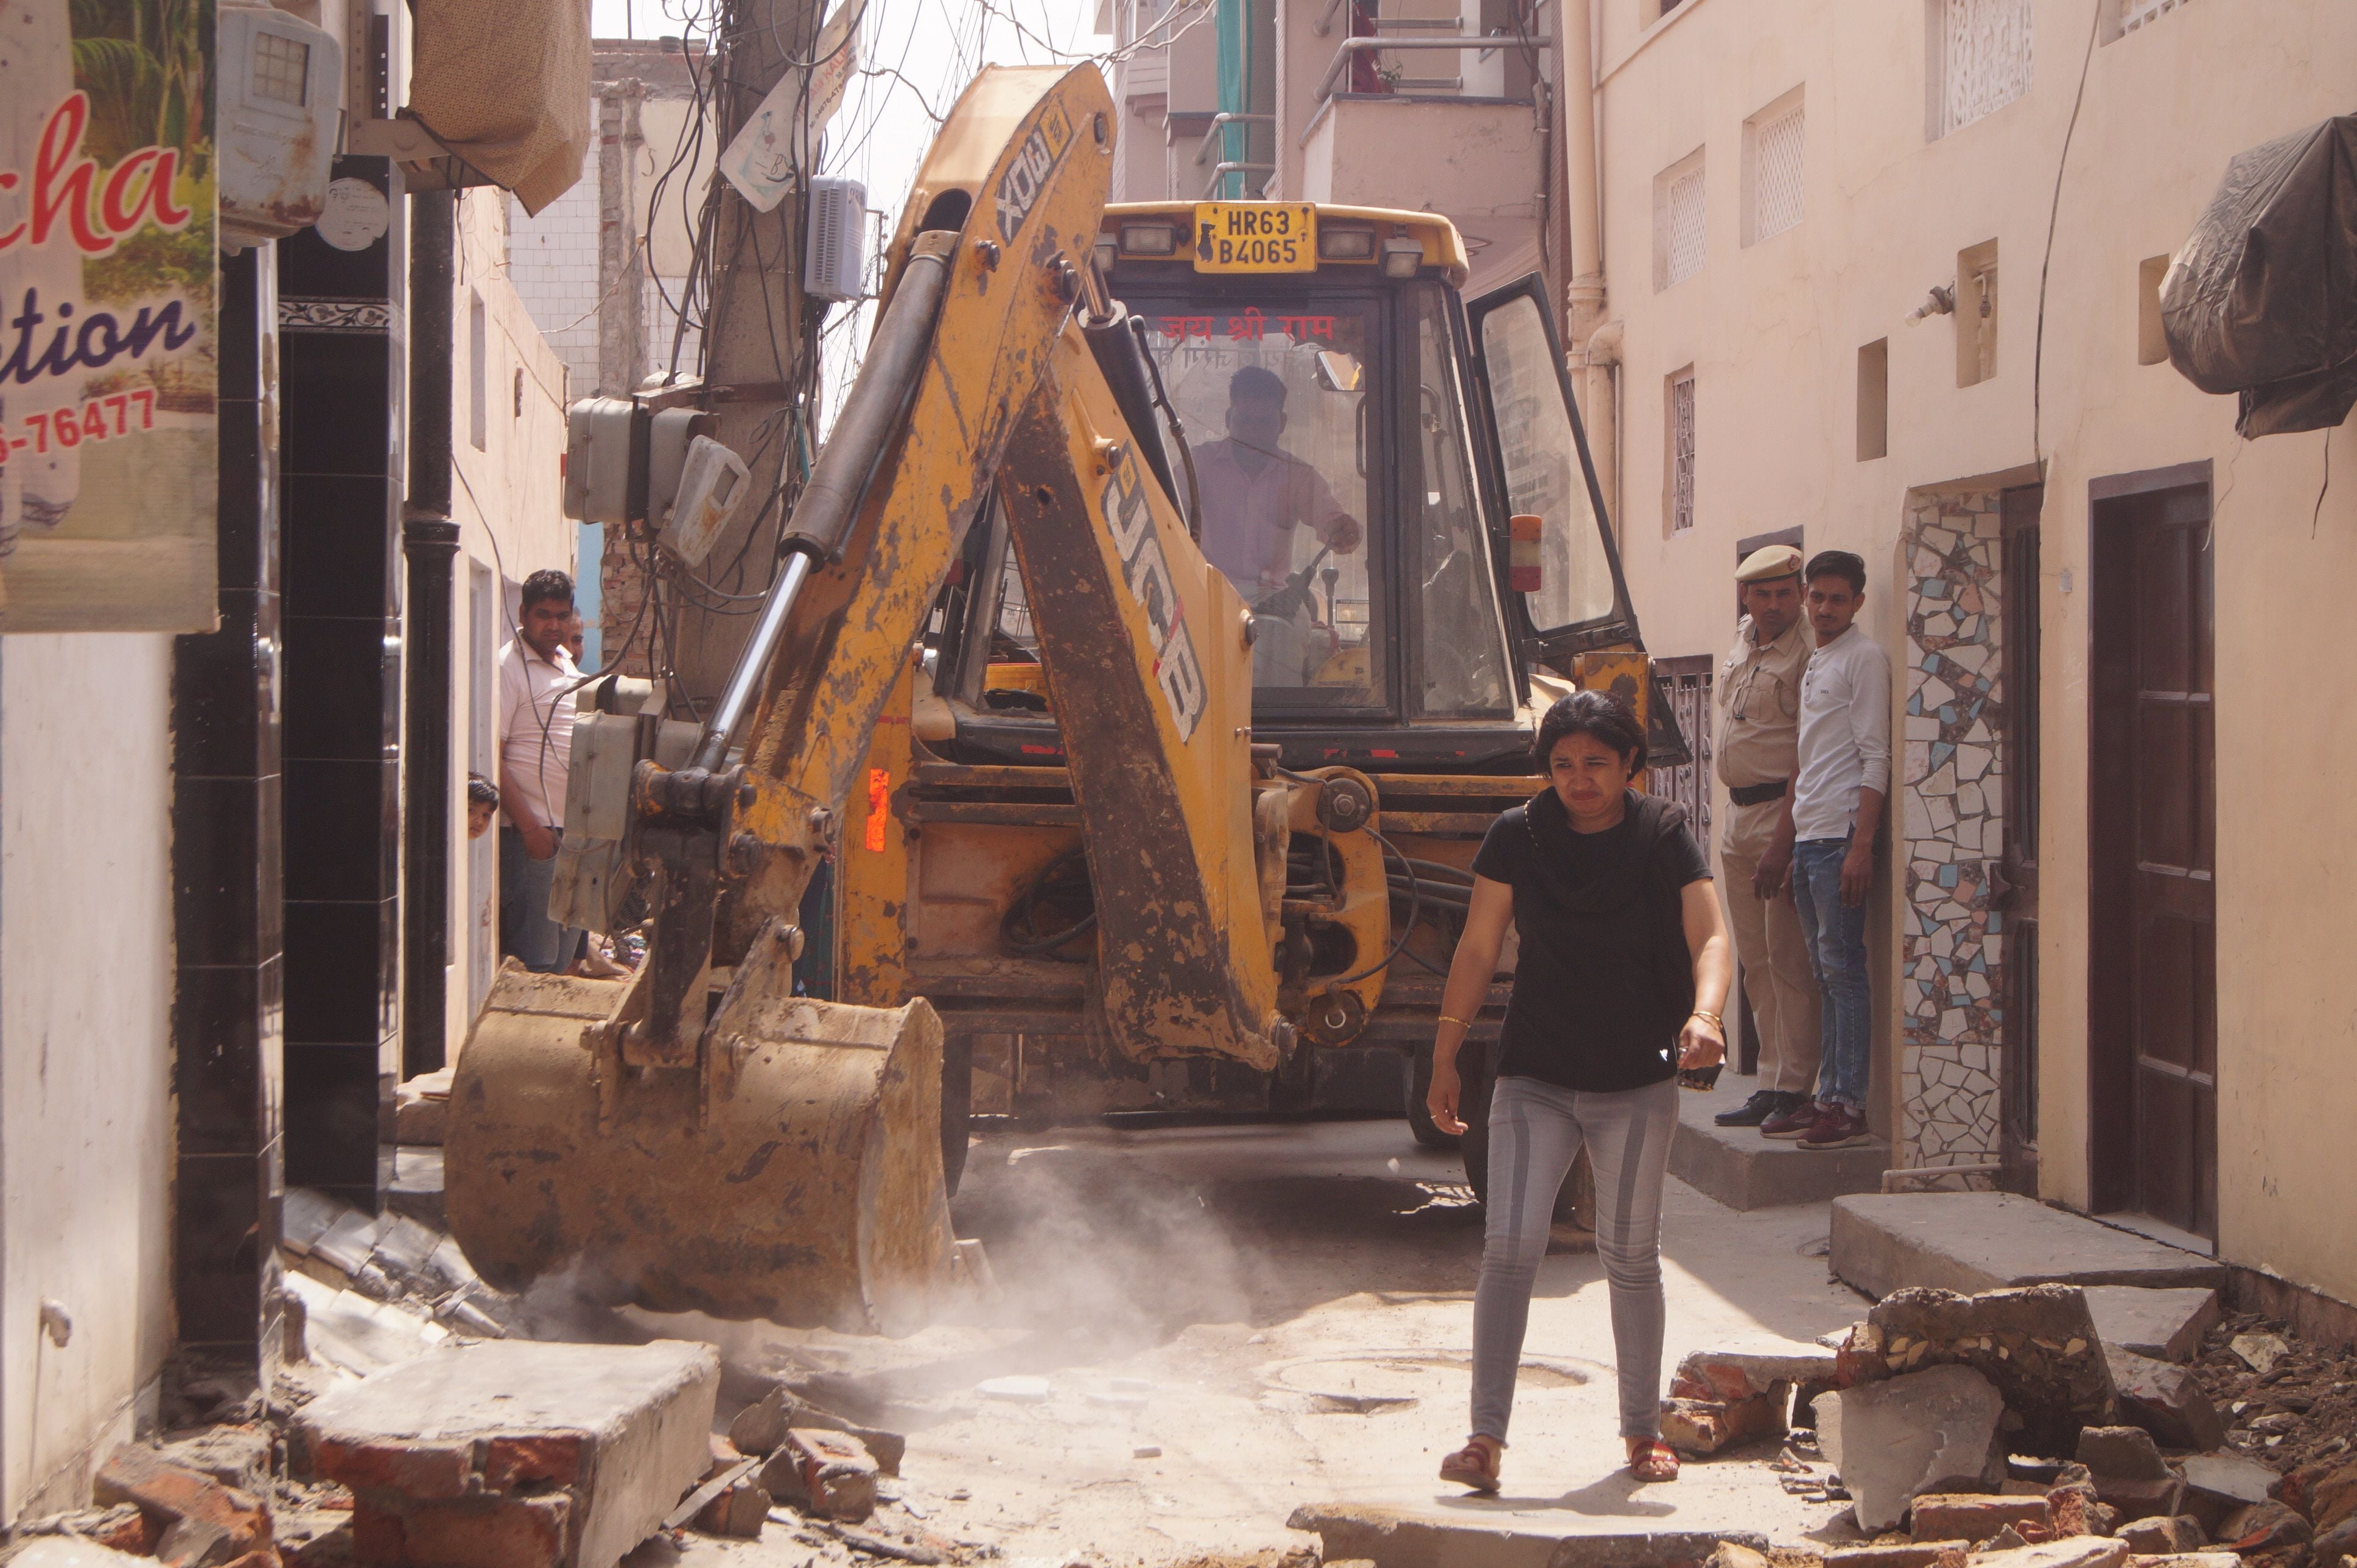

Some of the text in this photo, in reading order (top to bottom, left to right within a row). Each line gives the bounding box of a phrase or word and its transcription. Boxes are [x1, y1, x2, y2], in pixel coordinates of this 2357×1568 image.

[1228, 210, 1290, 236] HR63
[1219, 239, 1297, 264] B4065
[0, 287, 196, 385] tion
[1158, 306, 1337, 341] जय श्री राम
